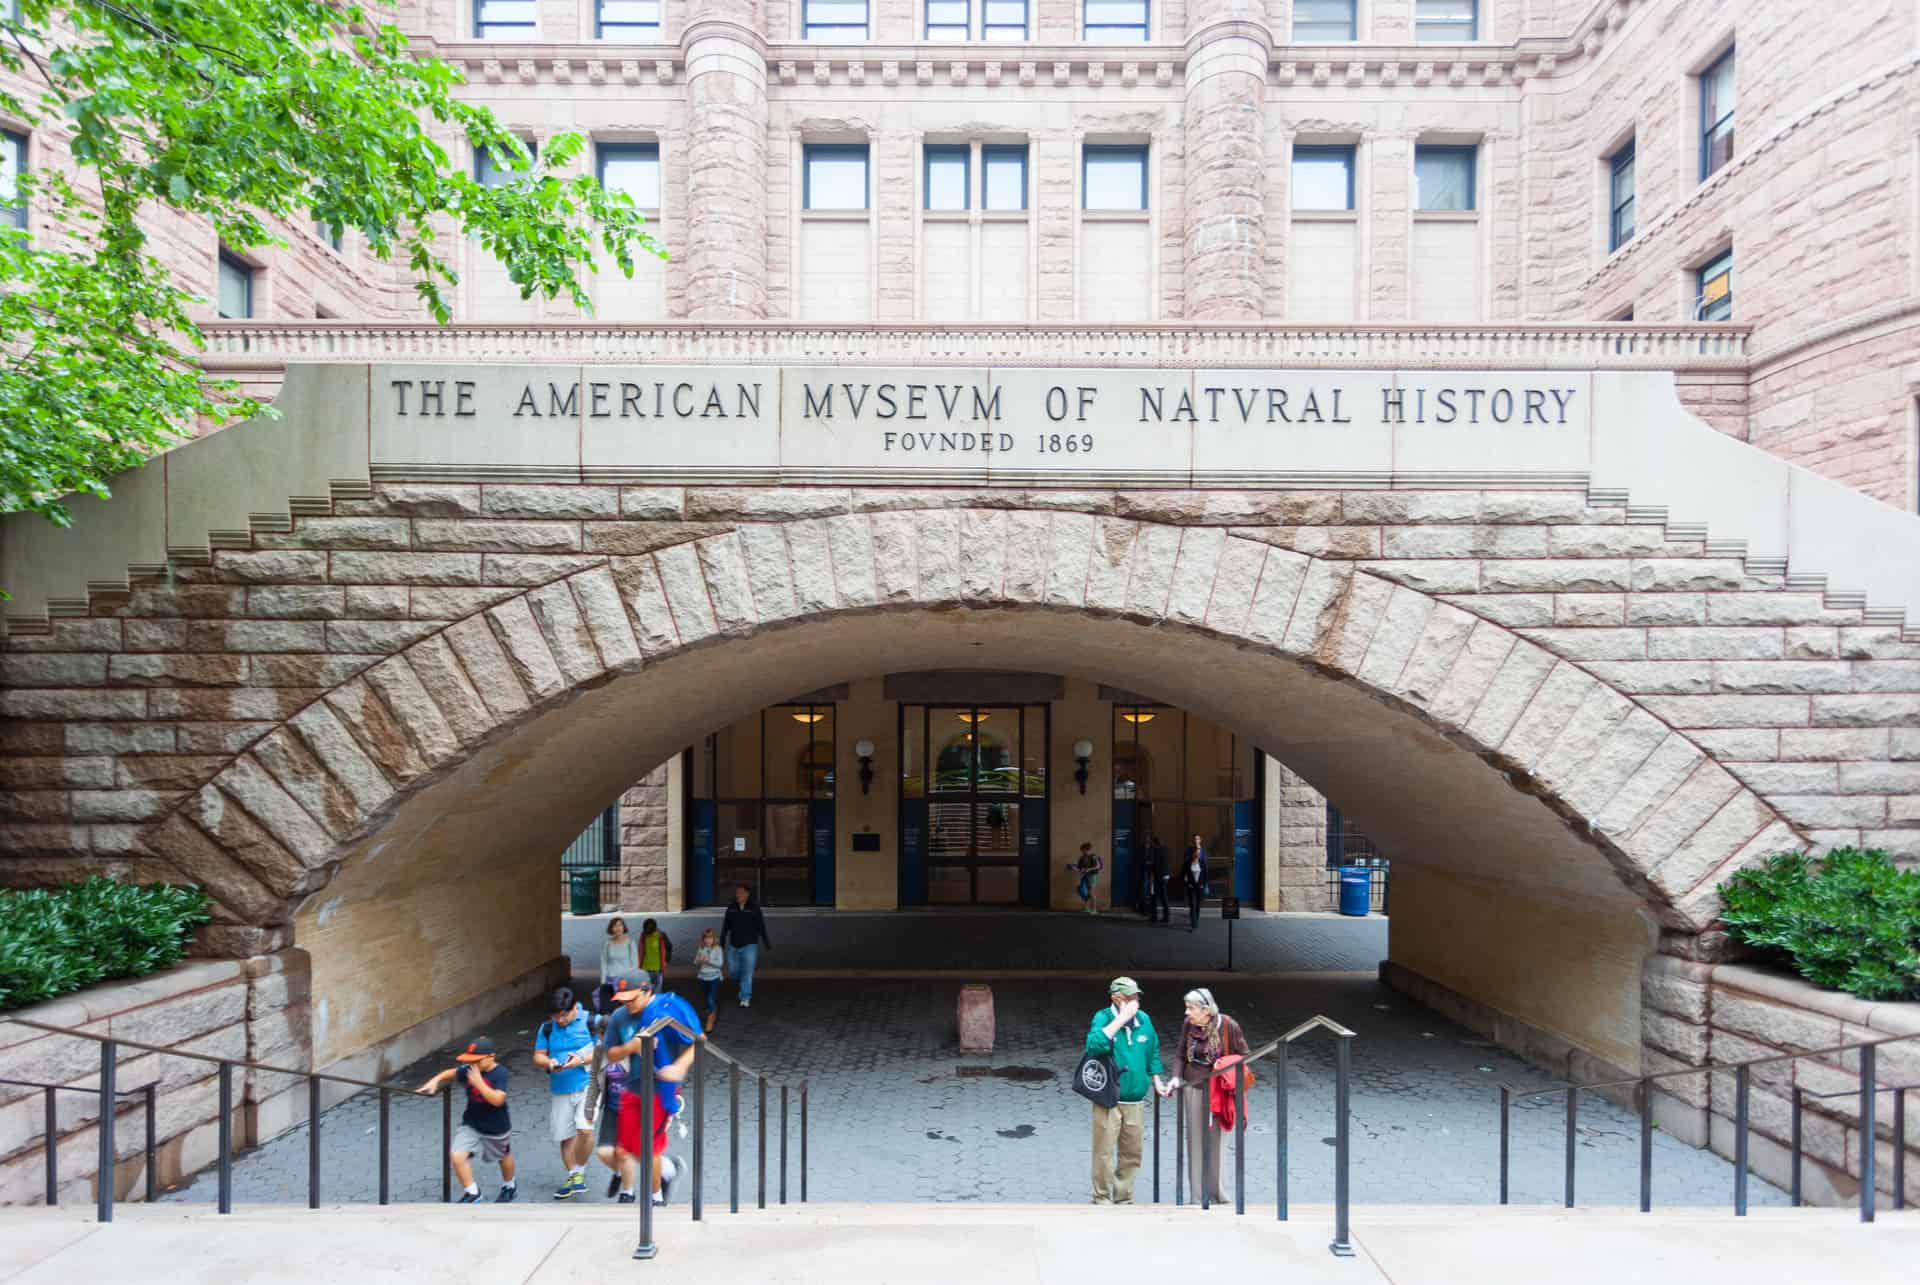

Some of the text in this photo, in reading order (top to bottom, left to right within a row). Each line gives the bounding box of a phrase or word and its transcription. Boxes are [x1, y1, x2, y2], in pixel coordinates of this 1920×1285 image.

[391, 380, 1577, 424] THE AMERICAN MVSEVM OF NATVRAL HISTORY
[884, 431, 1094, 454] FOVNDED 1869
